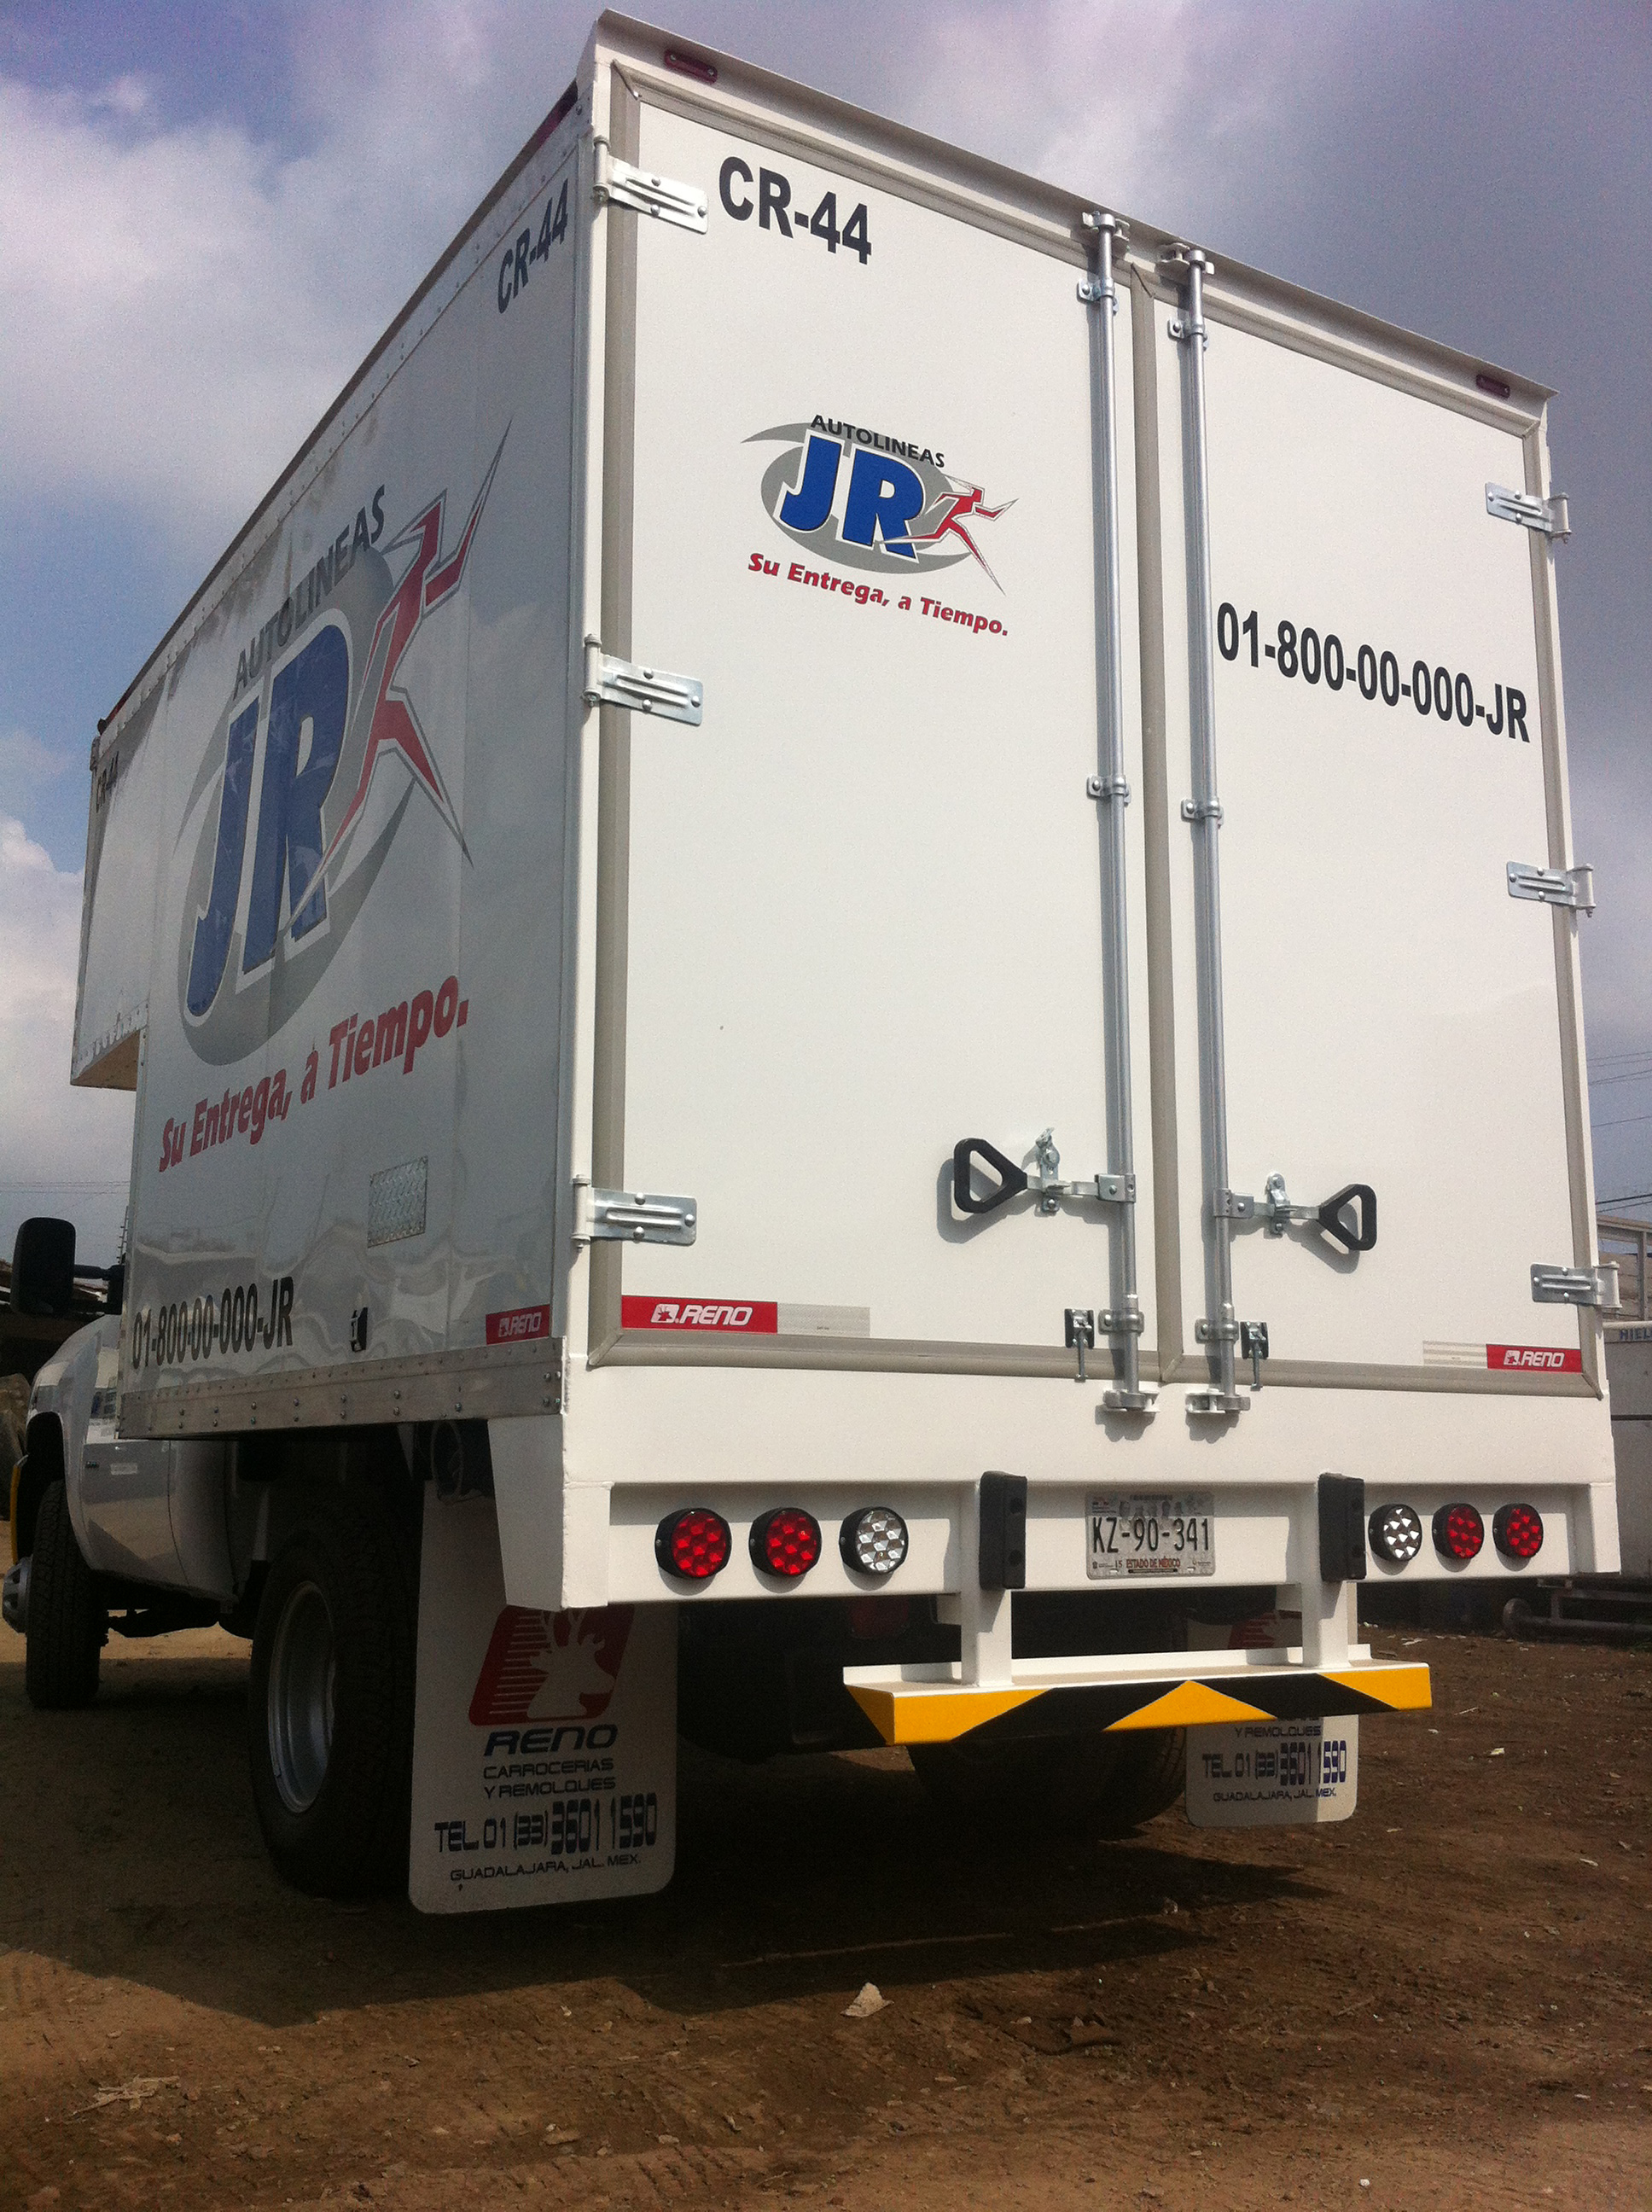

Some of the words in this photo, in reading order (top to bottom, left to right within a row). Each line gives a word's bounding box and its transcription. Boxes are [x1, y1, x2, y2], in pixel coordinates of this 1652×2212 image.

[719, 156, 872, 265] CR-44
[497, 178, 568, 313] CR-44
[811, 414, 945, 468] AUTOLINEAS
[778, 434, 924, 561] JR
[234, 483, 385, 701] AUTOLINEAS
[748, 552, 780, 576] Su
[788, 562, 889, 607] Entrega,
[898, 596, 911, 610] a
[921, 597, 1008, 636] Tiempo.
[1217, 602, 1530, 743] 01-800-00-000-JR
[187, 624, 349, 1017] JR
[159, 1117, 187, 1173] Su
[189, 1068, 293, 1157] Entrega,
[300, 1050, 319, 1104] a
[328, 975, 469, 1090] Tiempo.
[133, 1276, 294, 1370] 01-800-00-000-JR
[1092, 1516, 1209, 1553] KZ-90-341
[1126, 1558, 1149, 1569] ESTADO
[1149, 1558, 1158, 1568] DE
[484, 1724, 618, 1756] RENO
[1235, 1727, 1243, 1738] Y
[1245, 1726, 1321, 1738] REMOLQUES
[1236, 1753, 1250, 1778] 01
[1318, 1740, 1347, 1784] 1590
[483, 1758, 614, 1779] CARROCERIAS
[484, 1786, 495, 1799] Y
[499, 1777, 616, 1797] REMOLQUES
[483, 1817, 506, 1848] 01
[513, 1809, 549, 1850] (33)
[551, 1798, 600, 1855] 3601
[610, 1792, 658, 1849] 1590
[451, 1860, 569, 1882] GUADALAJARA,
